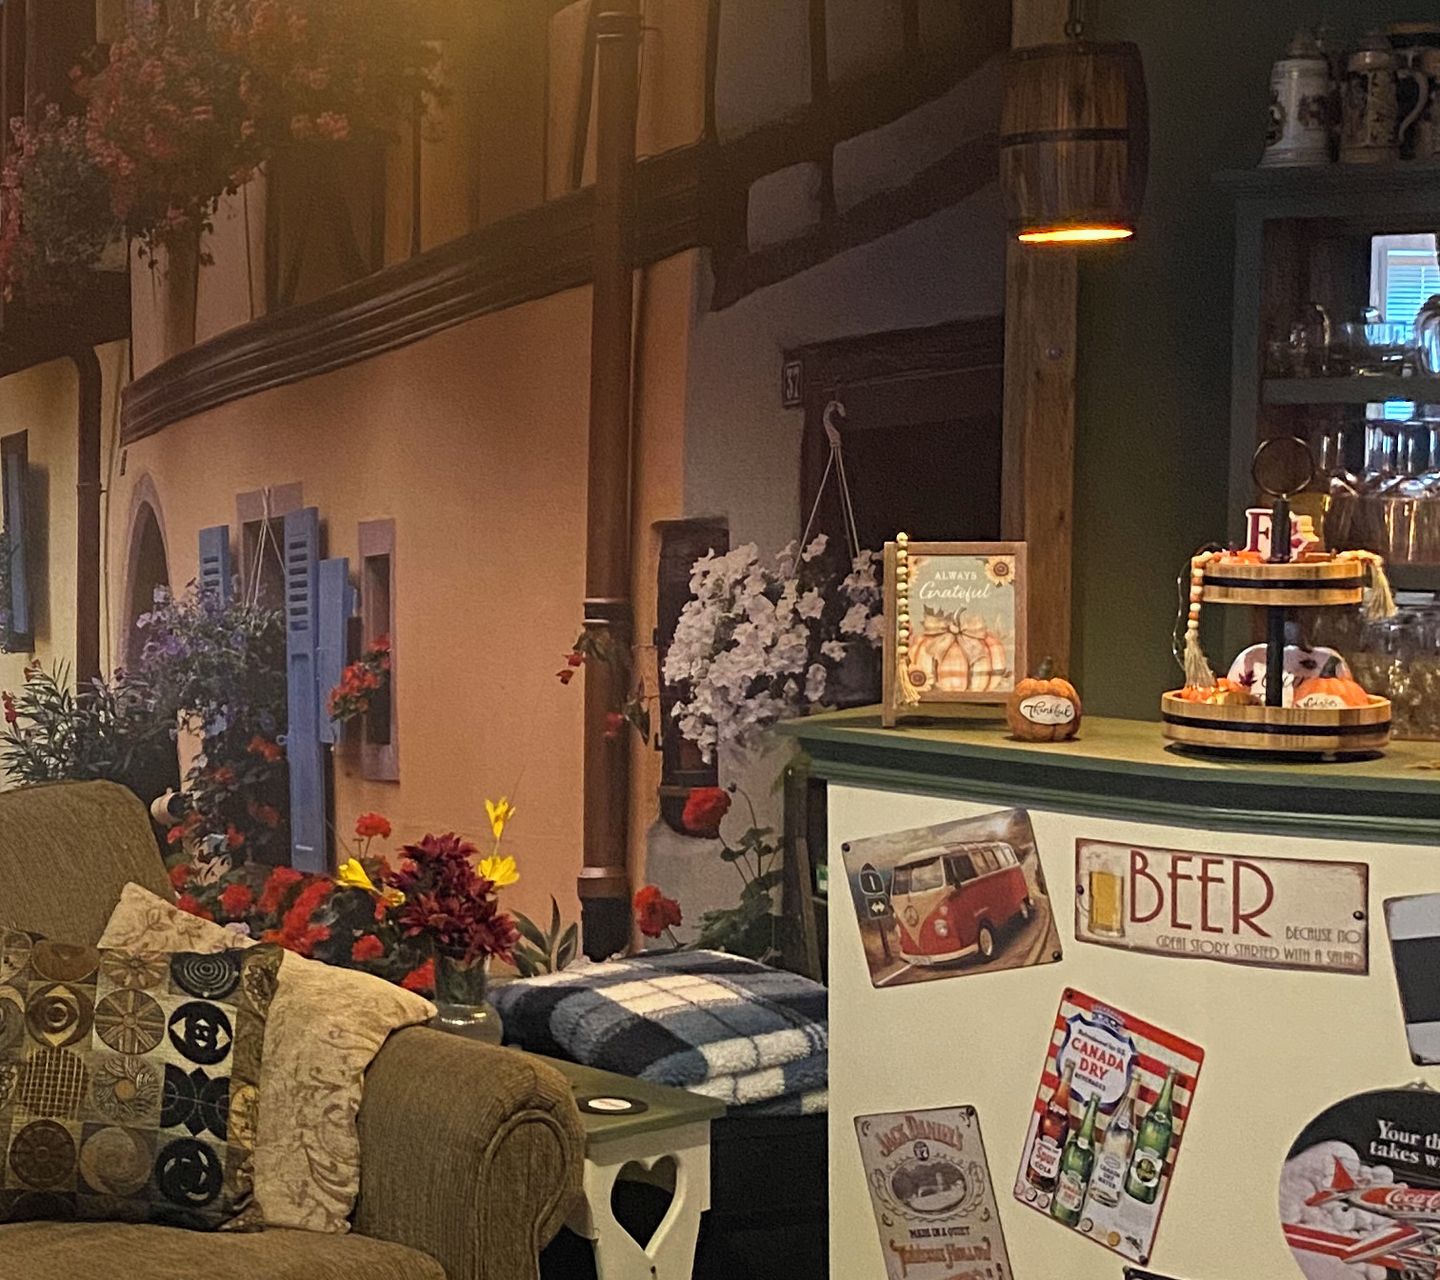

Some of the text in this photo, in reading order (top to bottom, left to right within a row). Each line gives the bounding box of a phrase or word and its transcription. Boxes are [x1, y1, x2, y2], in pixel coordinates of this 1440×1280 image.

[934, 570, 978, 581] ALWAYS
[919, 581, 991, 603] Grateful
[1023, 701, 1074, 719] Thankful
[1129, 849, 1275, 938] BEER
[1285, 925, 1361, 944] BECAUSE NO
[1156, 935, 1186, 951] GREAT
[1190, 939, 1230, 955] STORY
[1234, 944, 1280, 961] STARTED
[1283, 945, 1311, 962] WITH
[1315, 949, 1322, 962] A
[1071, 1037, 1125, 1073] CANADA
[1079, 1057, 1108, 1081] DRY
[875, 1123, 910, 1157] JACK
[1377, 1119, 1421, 1146] Your
[1370, 1140, 1420, 1164] takes
[1034, 1161, 1052, 1175] COLA
